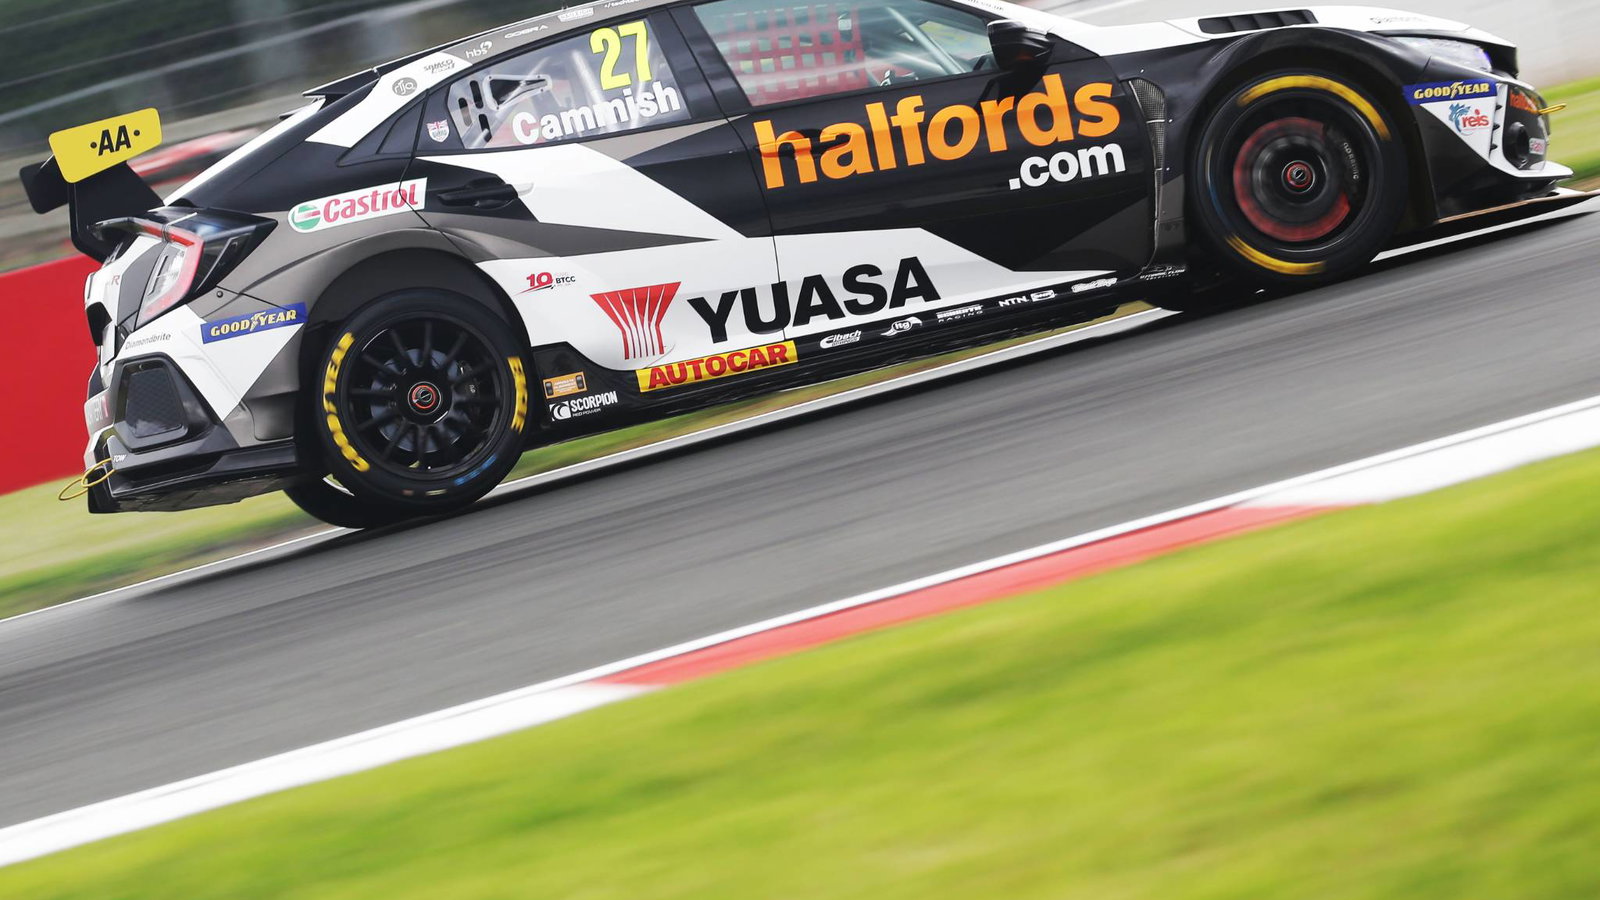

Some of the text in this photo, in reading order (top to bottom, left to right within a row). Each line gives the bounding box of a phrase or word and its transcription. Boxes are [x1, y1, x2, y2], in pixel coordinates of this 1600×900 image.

[588, 19, 652, 90] 27
[512, 80, 681, 145] Cammish
[753, 73, 1121, 189] halfords
[1462, 109, 1489, 128] reis
[1008, 142, 1127, 190] .com
[323, 183, 419, 223] Castrol
[526, 272, 553, 287] 10
[556, 276, 576, 284] BTCC
[687, 257, 941, 344] YUASA
[938, 310, 983, 323] RACING
[998, 296, 1027, 307] NTN
[648, 343, 789, 389] AUTOCAR
[570, 391, 618, 412] SCORPION
